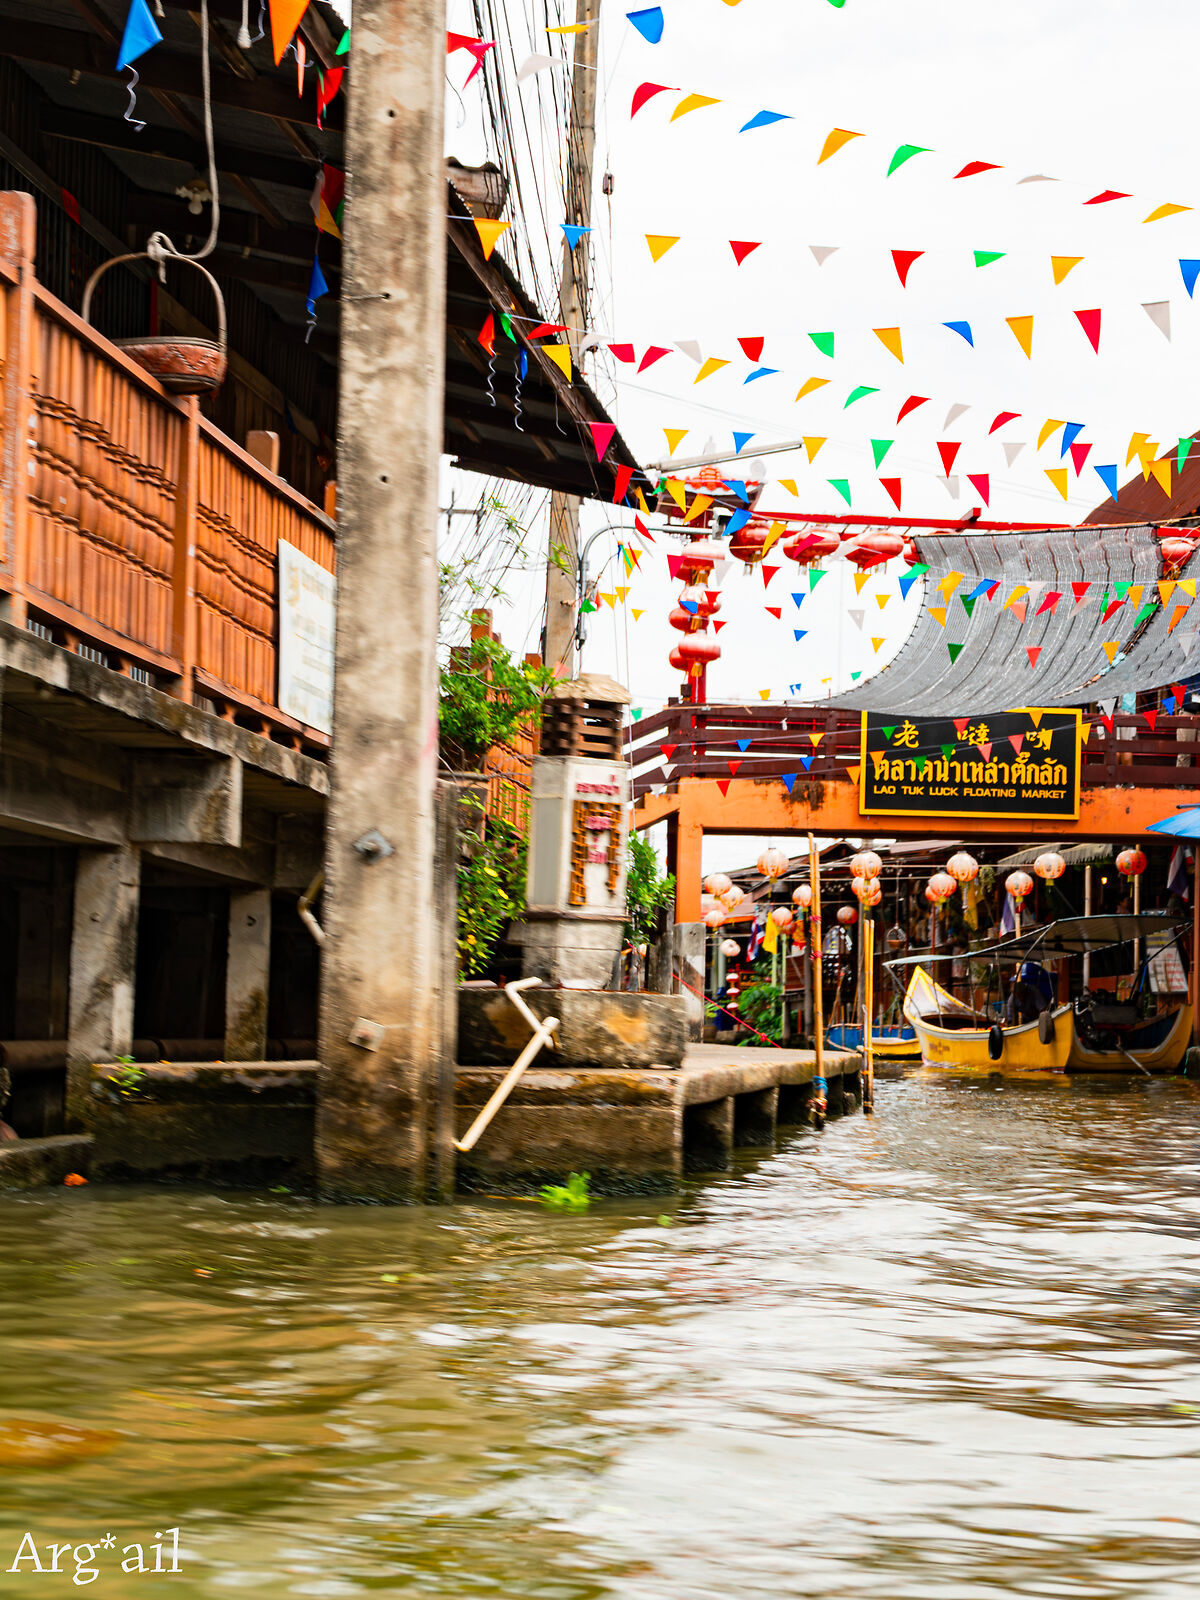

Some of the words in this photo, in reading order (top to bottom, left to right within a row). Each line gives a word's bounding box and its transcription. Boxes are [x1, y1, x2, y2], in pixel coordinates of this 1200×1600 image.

[873, 785, 896, 795] LAO
[901, 786, 925, 796] TUK
[929, 786, 959, 797] LUCK
[963, 787, 1016, 798] FLOATING
[1022, 789, 1067, 799] MARKET
